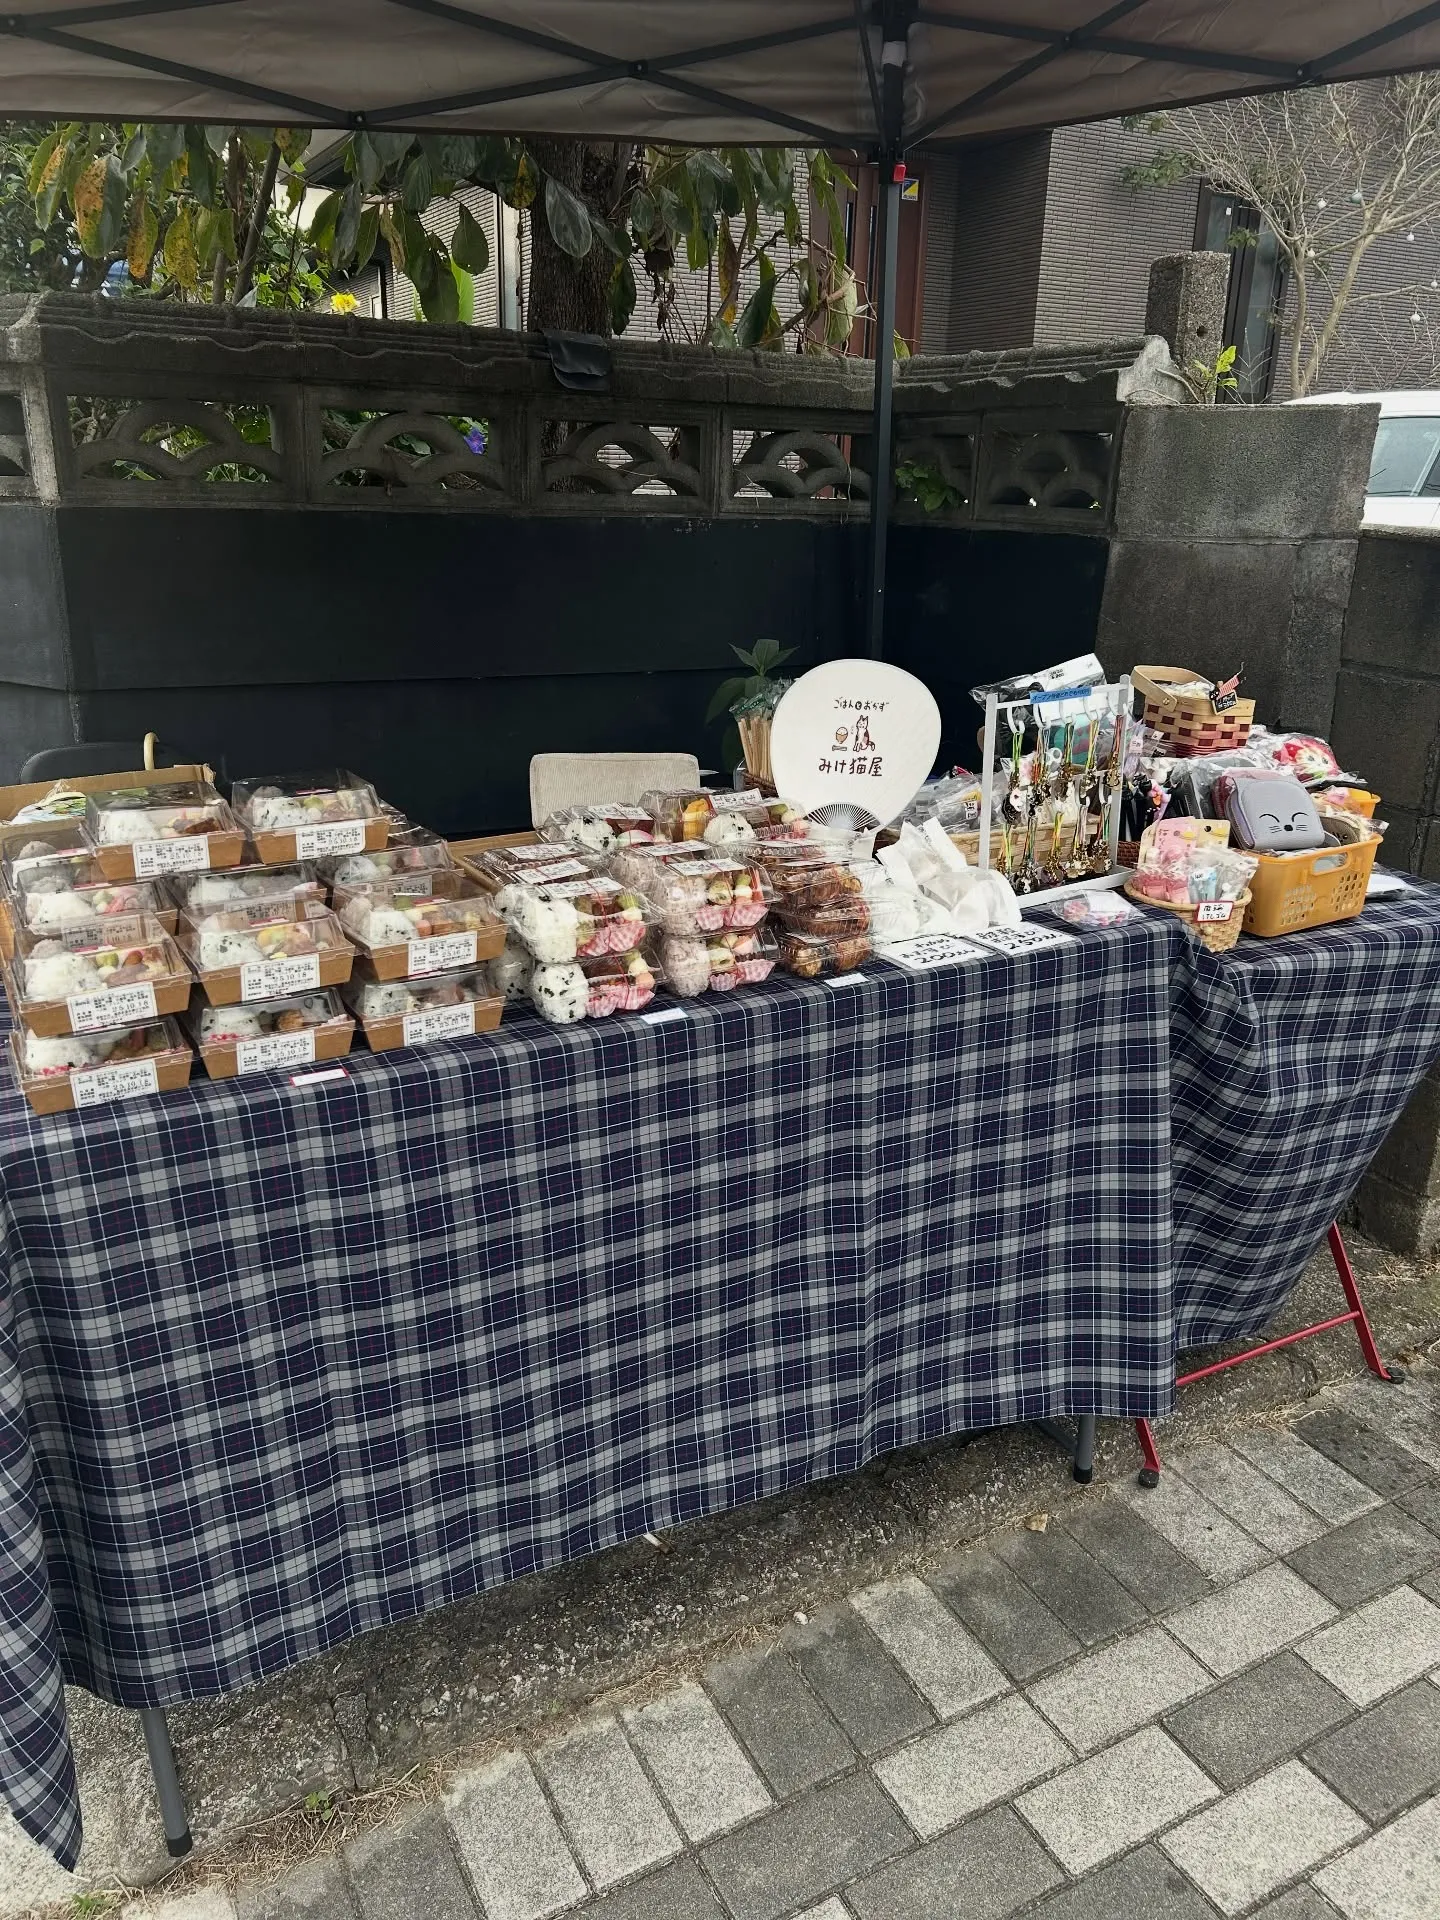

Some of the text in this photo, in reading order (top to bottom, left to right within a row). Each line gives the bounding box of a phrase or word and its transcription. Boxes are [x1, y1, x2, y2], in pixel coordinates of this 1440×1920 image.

[834, 697, 889, 712] ごはんとおかず
[819, 756, 882, 776] みけ猫屋
